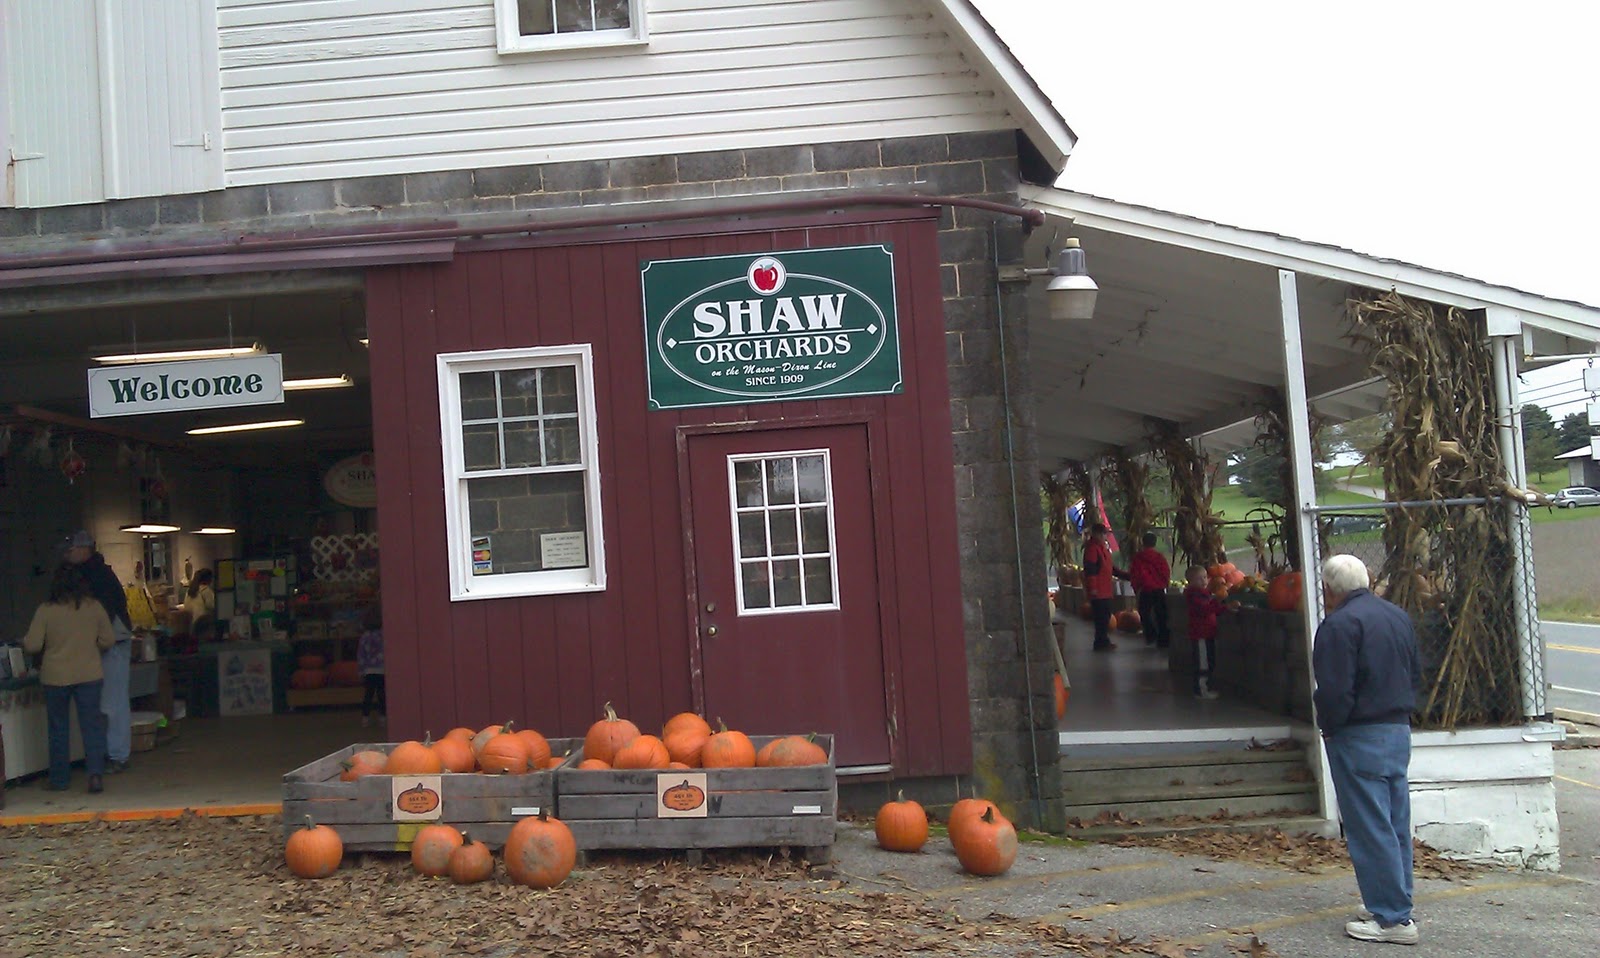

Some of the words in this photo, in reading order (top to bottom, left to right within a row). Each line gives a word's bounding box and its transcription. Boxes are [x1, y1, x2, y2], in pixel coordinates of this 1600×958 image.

[693, 293, 847, 338] SHAW
[695, 333, 851, 364] ORCHARDS
[725, 366, 739, 376] the
[743, 362, 810, 374] Mason-Dixon
[814, 360, 837, 370] Line
[745, 376, 776, 386] SINCE
[780, 374, 804, 384] 1909
[108, 373, 262, 404] Welcome
